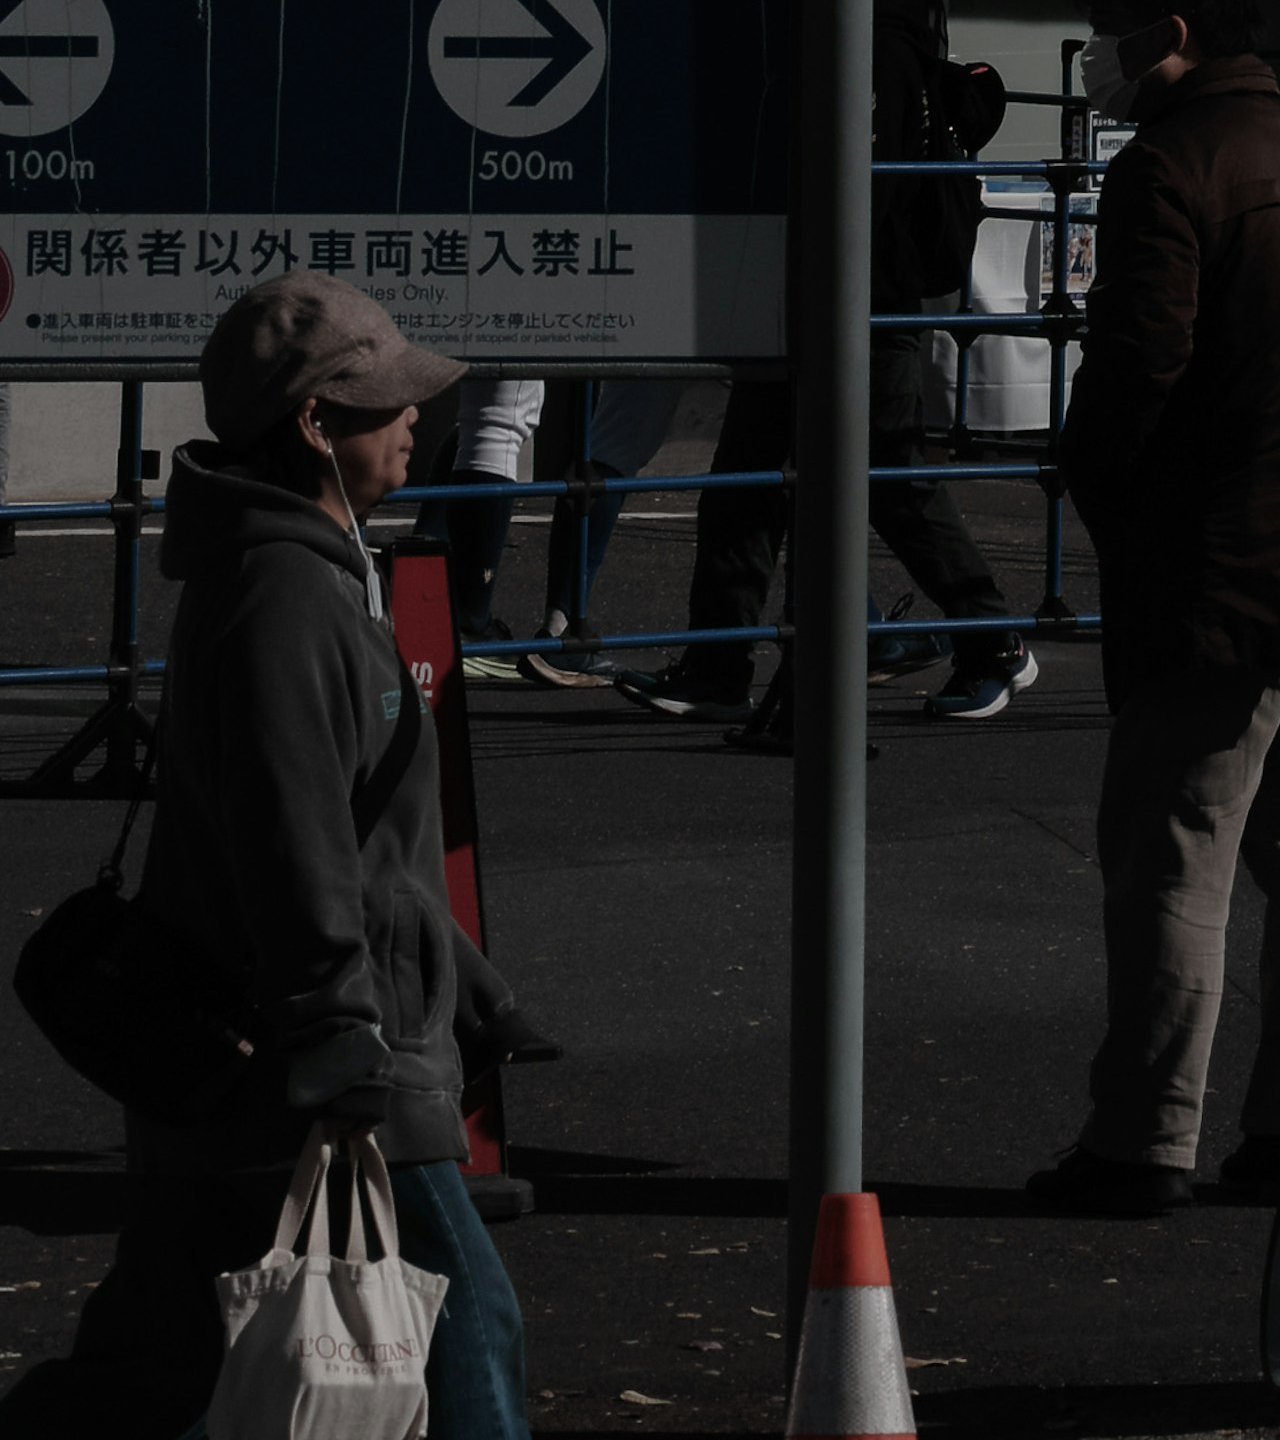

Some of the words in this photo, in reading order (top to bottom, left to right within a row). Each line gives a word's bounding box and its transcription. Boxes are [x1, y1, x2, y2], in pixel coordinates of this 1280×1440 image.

[5, 149, 95, 181] 100m
[478, 150, 574, 182] 500m
[26, 229, 636, 278] 関係者以外車両進入禁止
[403, 284, 449, 304] Only.
[42, 333, 78, 343] Please
[80, 334, 121, 345] present
[125, 335, 147, 345] your
[151, 333, 189, 345] parking
